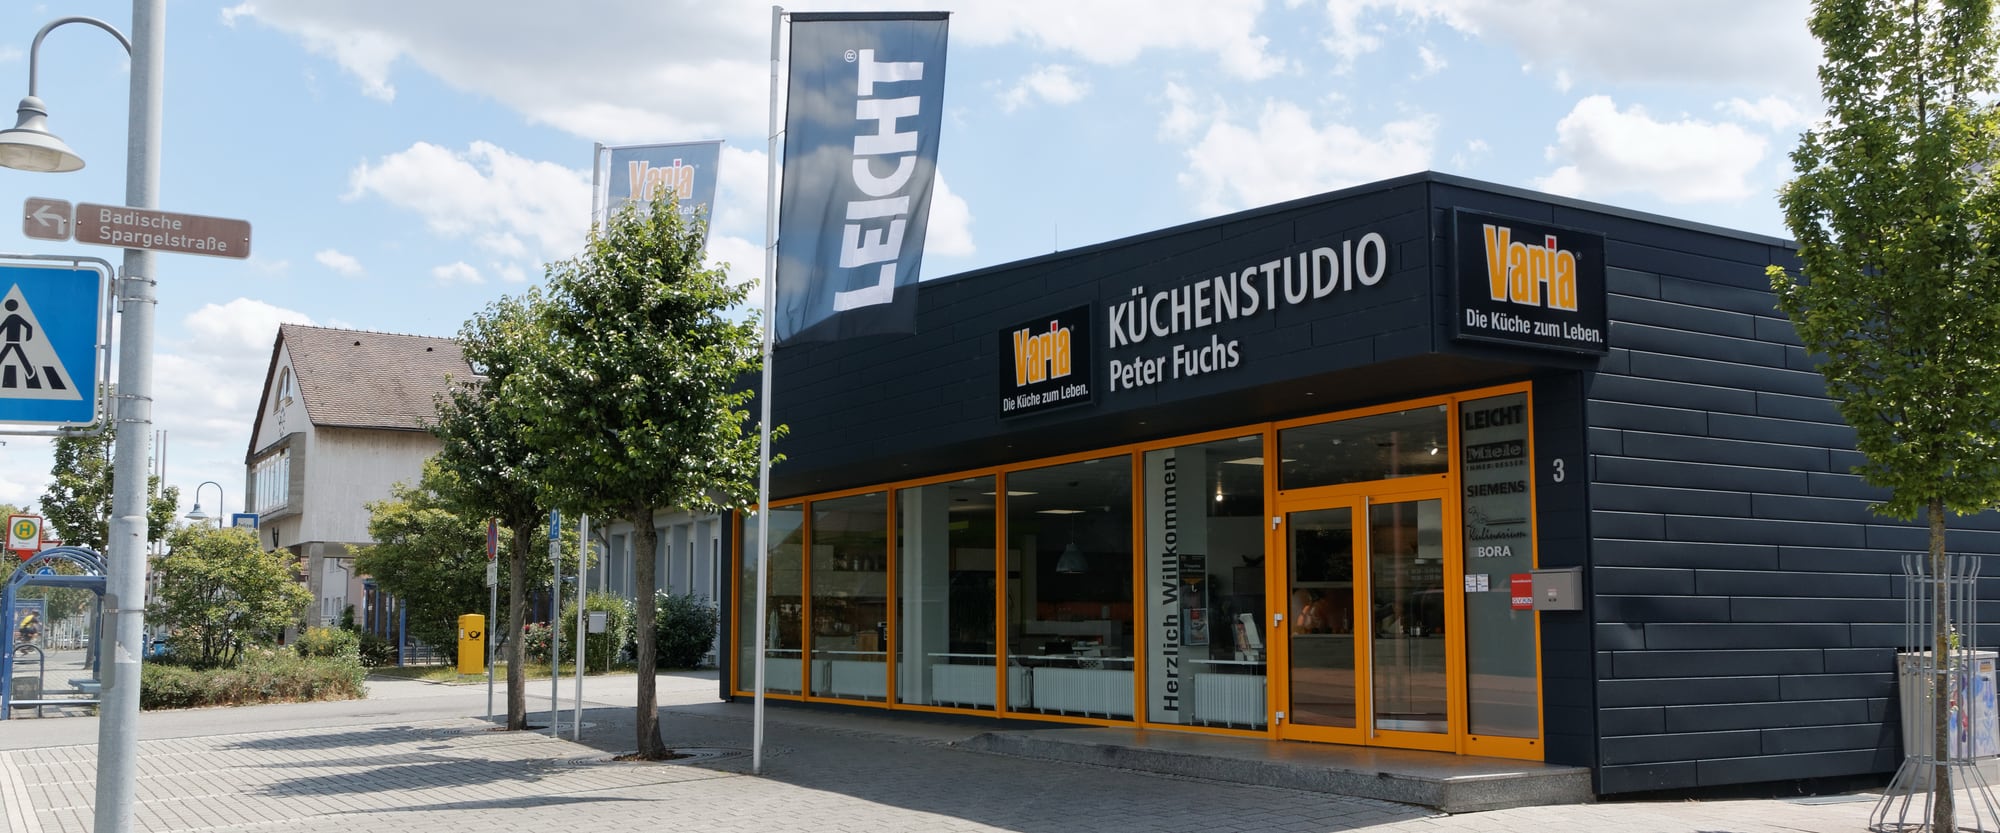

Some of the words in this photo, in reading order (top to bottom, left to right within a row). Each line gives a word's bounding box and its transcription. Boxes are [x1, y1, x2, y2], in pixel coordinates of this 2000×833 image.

[628, 158, 695, 202] Varia
[833, 49, 924, 312] LEICHT
[99, 208, 183, 231] Badische
[99, 225, 228, 252] Spargelstraße
[1482, 223, 1578, 313] Varia
[1109, 232, 1388, 349] KÜCHENSTUDIO
[1466, 308, 1488, 328] Die
[1491, 312, 1531, 335] Küche
[1534, 321, 1560, 338] zum
[1563, 321, 1604, 343] Leben.
[1013, 319, 1072, 388] Varia
[1109, 355, 1166, 392] Peter
[1172, 334, 1240, 380] Fuchs
[1003, 397, 1016, 412] Die
[1017, 392, 1041, 409] Küche
[1042, 389, 1060, 403] zum
[1061, 383, 1089, 400] Leben.
[1465, 405, 1524, 431] LEICHT
[1467, 444, 1522, 462] Miele
[1553, 458, 1565, 483] 3
[1467, 480, 1526, 498] SIEMENS
[1162, 457, 1177, 606] Willkommen
[1478, 545, 1512, 558] BORA
[1163, 613, 1179, 712] Herzlich
